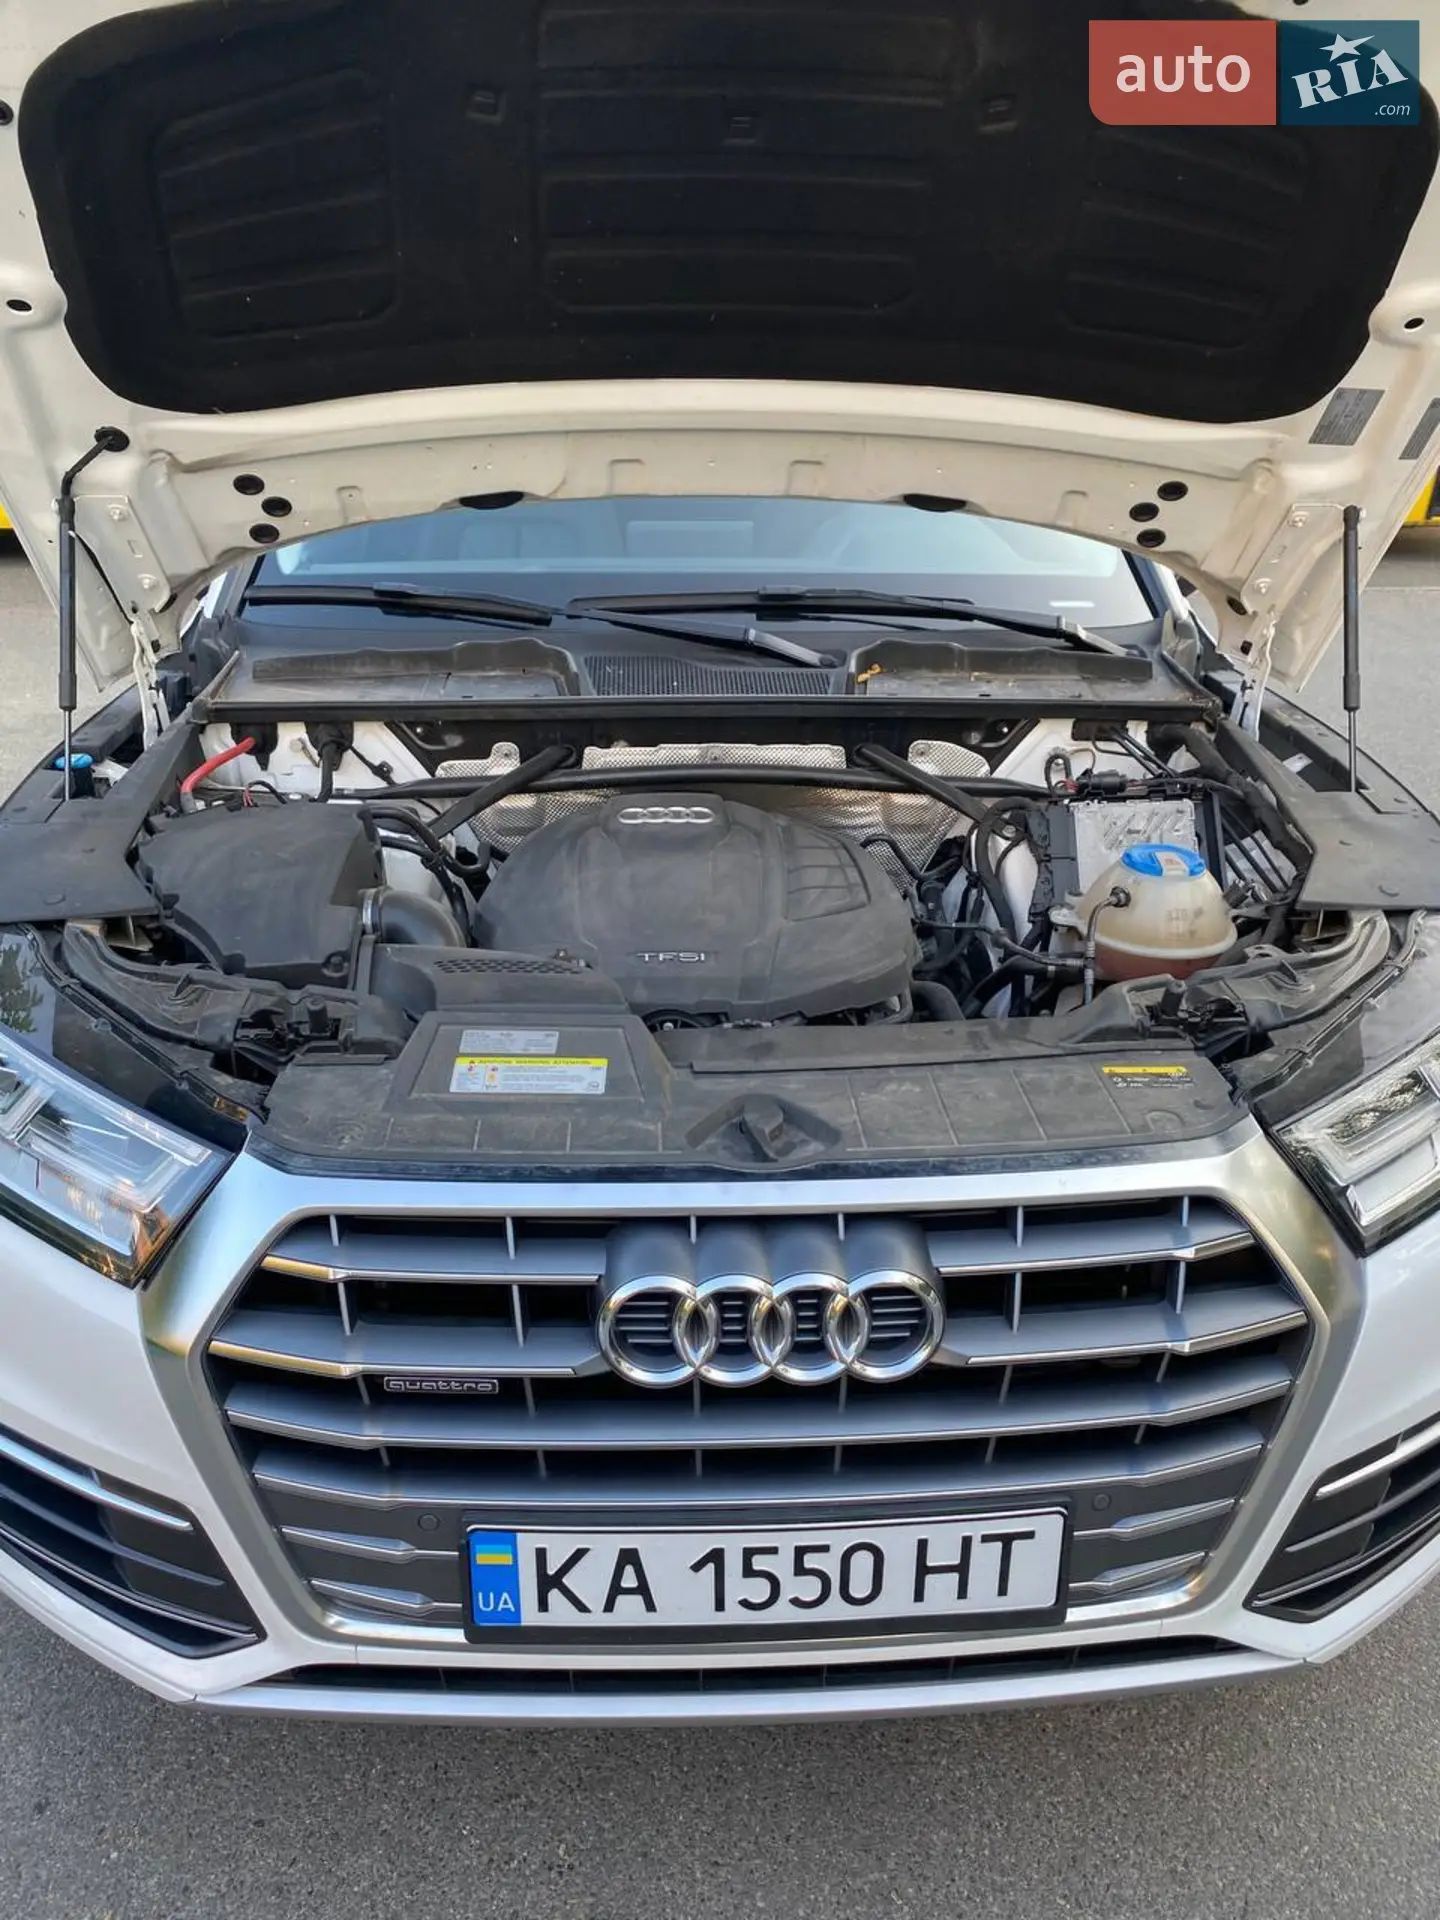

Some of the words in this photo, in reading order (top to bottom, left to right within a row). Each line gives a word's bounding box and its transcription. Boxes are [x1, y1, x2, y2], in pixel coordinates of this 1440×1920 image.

[636, 952, 705, 961] TFSI
[389, 1380, 493, 1391] quattro
[534, 1546, 657, 1613] KA
[689, 1541, 885, 1612] 1550
[913, 1529, 1036, 1602] HT
[477, 1591, 515, 1612] UA
